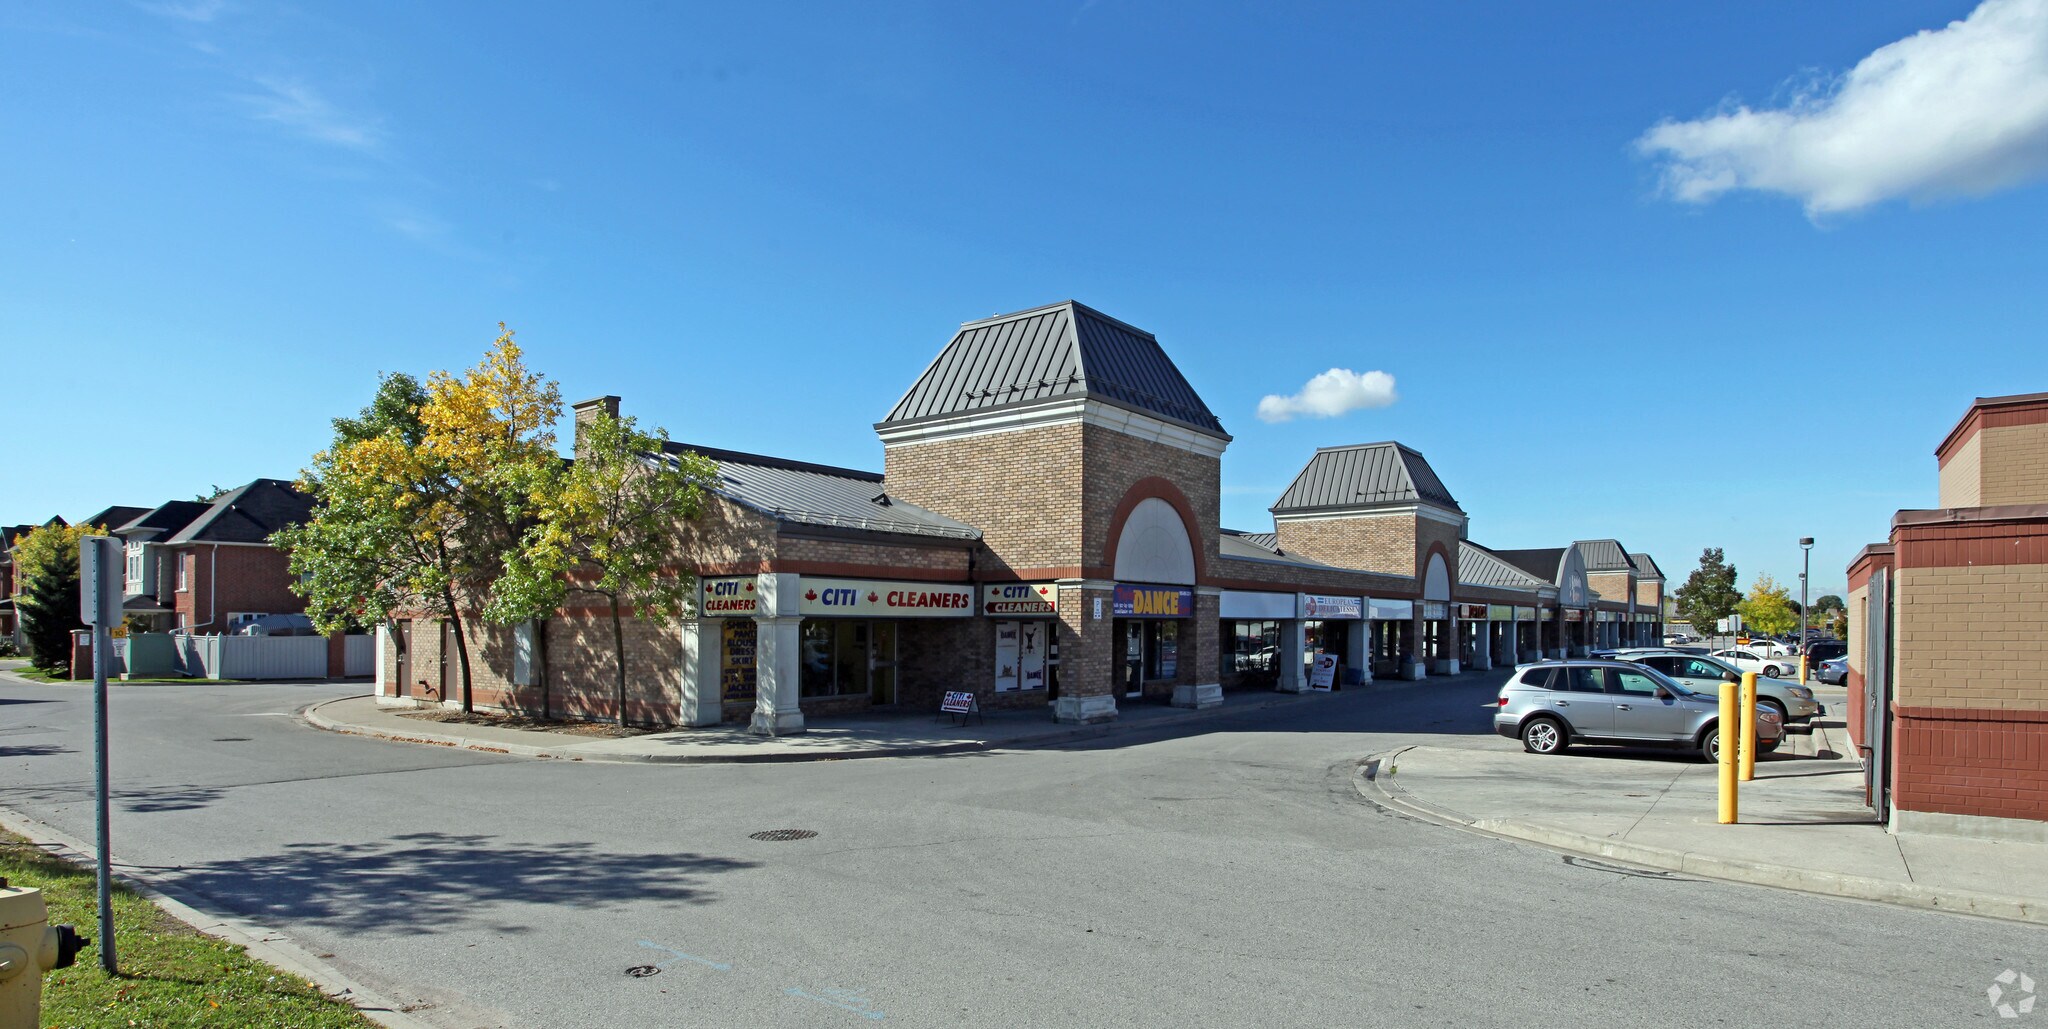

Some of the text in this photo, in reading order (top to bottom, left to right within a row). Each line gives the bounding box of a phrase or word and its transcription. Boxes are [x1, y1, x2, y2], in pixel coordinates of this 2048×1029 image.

[715, 582, 738, 595] CITI
[1003, 586, 1029, 598] CITI
[822, 588, 969, 608] CITI CLEANERS
[1133, 589, 1180, 615] DANCE
[705, 599, 756, 610] CLEANERS
[994, 602, 1052, 612] CLEANERS
[729, 648, 755, 656] DRESS
[731, 657, 754, 665] SKIRT
[943, 698, 971, 708] CLEANERS
